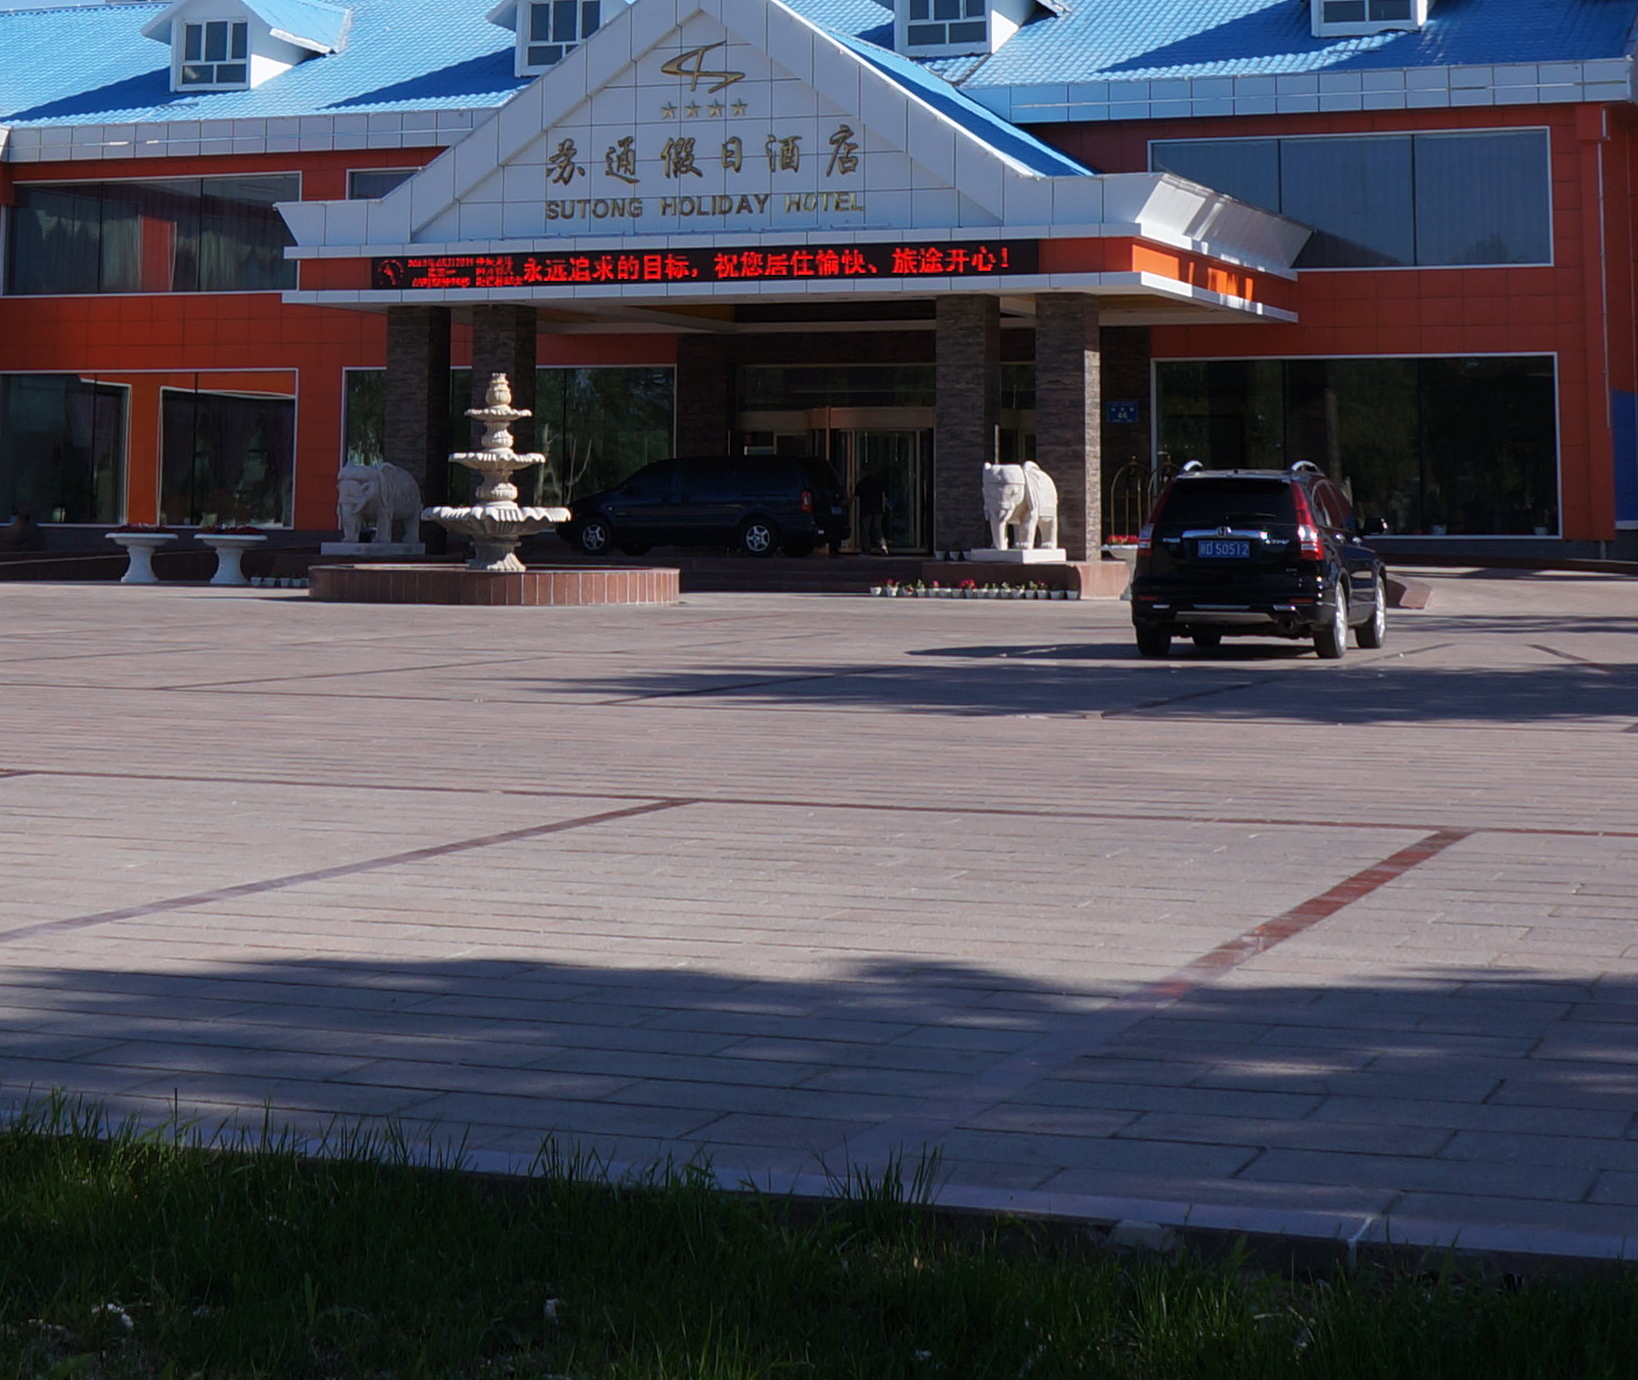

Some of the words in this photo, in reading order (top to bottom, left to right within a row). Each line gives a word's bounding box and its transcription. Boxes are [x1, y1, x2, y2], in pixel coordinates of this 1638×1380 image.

[545, 124, 861, 186] 苏通假日酒店
[545, 197, 644, 220] SUTONG
[660, 193, 770, 217] HOLIDAY
[784, 191, 865, 214] HOTEL
